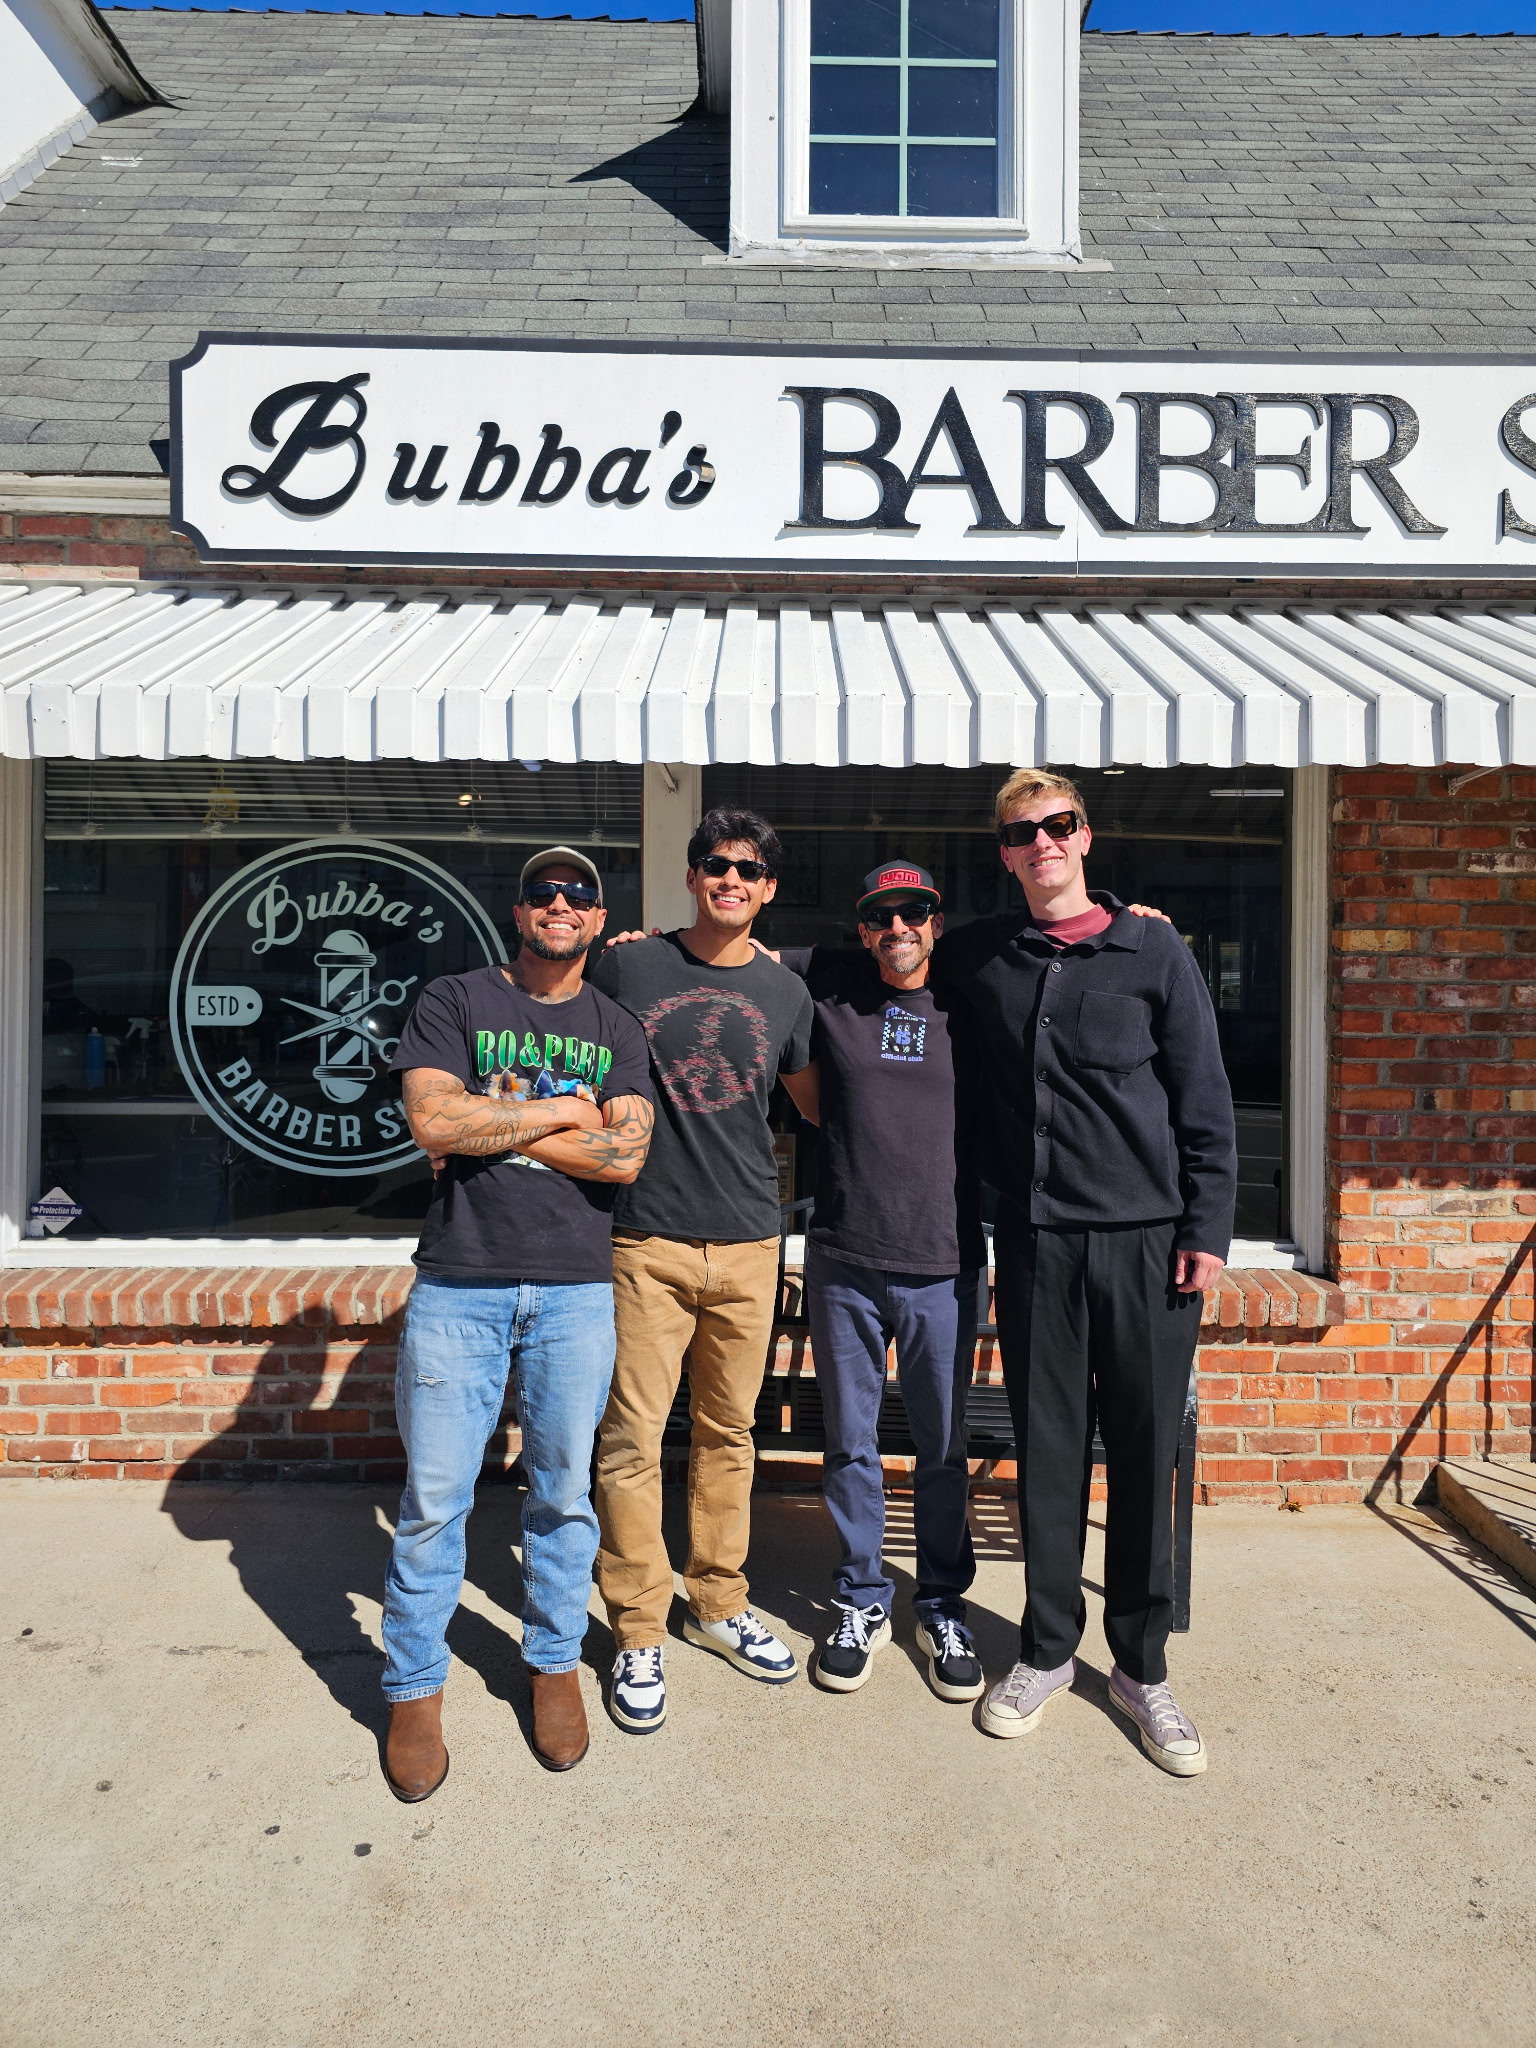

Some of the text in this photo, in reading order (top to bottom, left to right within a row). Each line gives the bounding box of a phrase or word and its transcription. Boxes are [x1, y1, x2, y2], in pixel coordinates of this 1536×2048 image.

[220, 372, 716, 516] Bubba's
[783, 385, 1448, 535] BARBER
[247, 875, 445, 955] Bubba's
[198, 995, 239, 1016] ESTD
[217, 1056, 363, 1148] BARBER
[39, 1206, 82, 1215] Protection One
